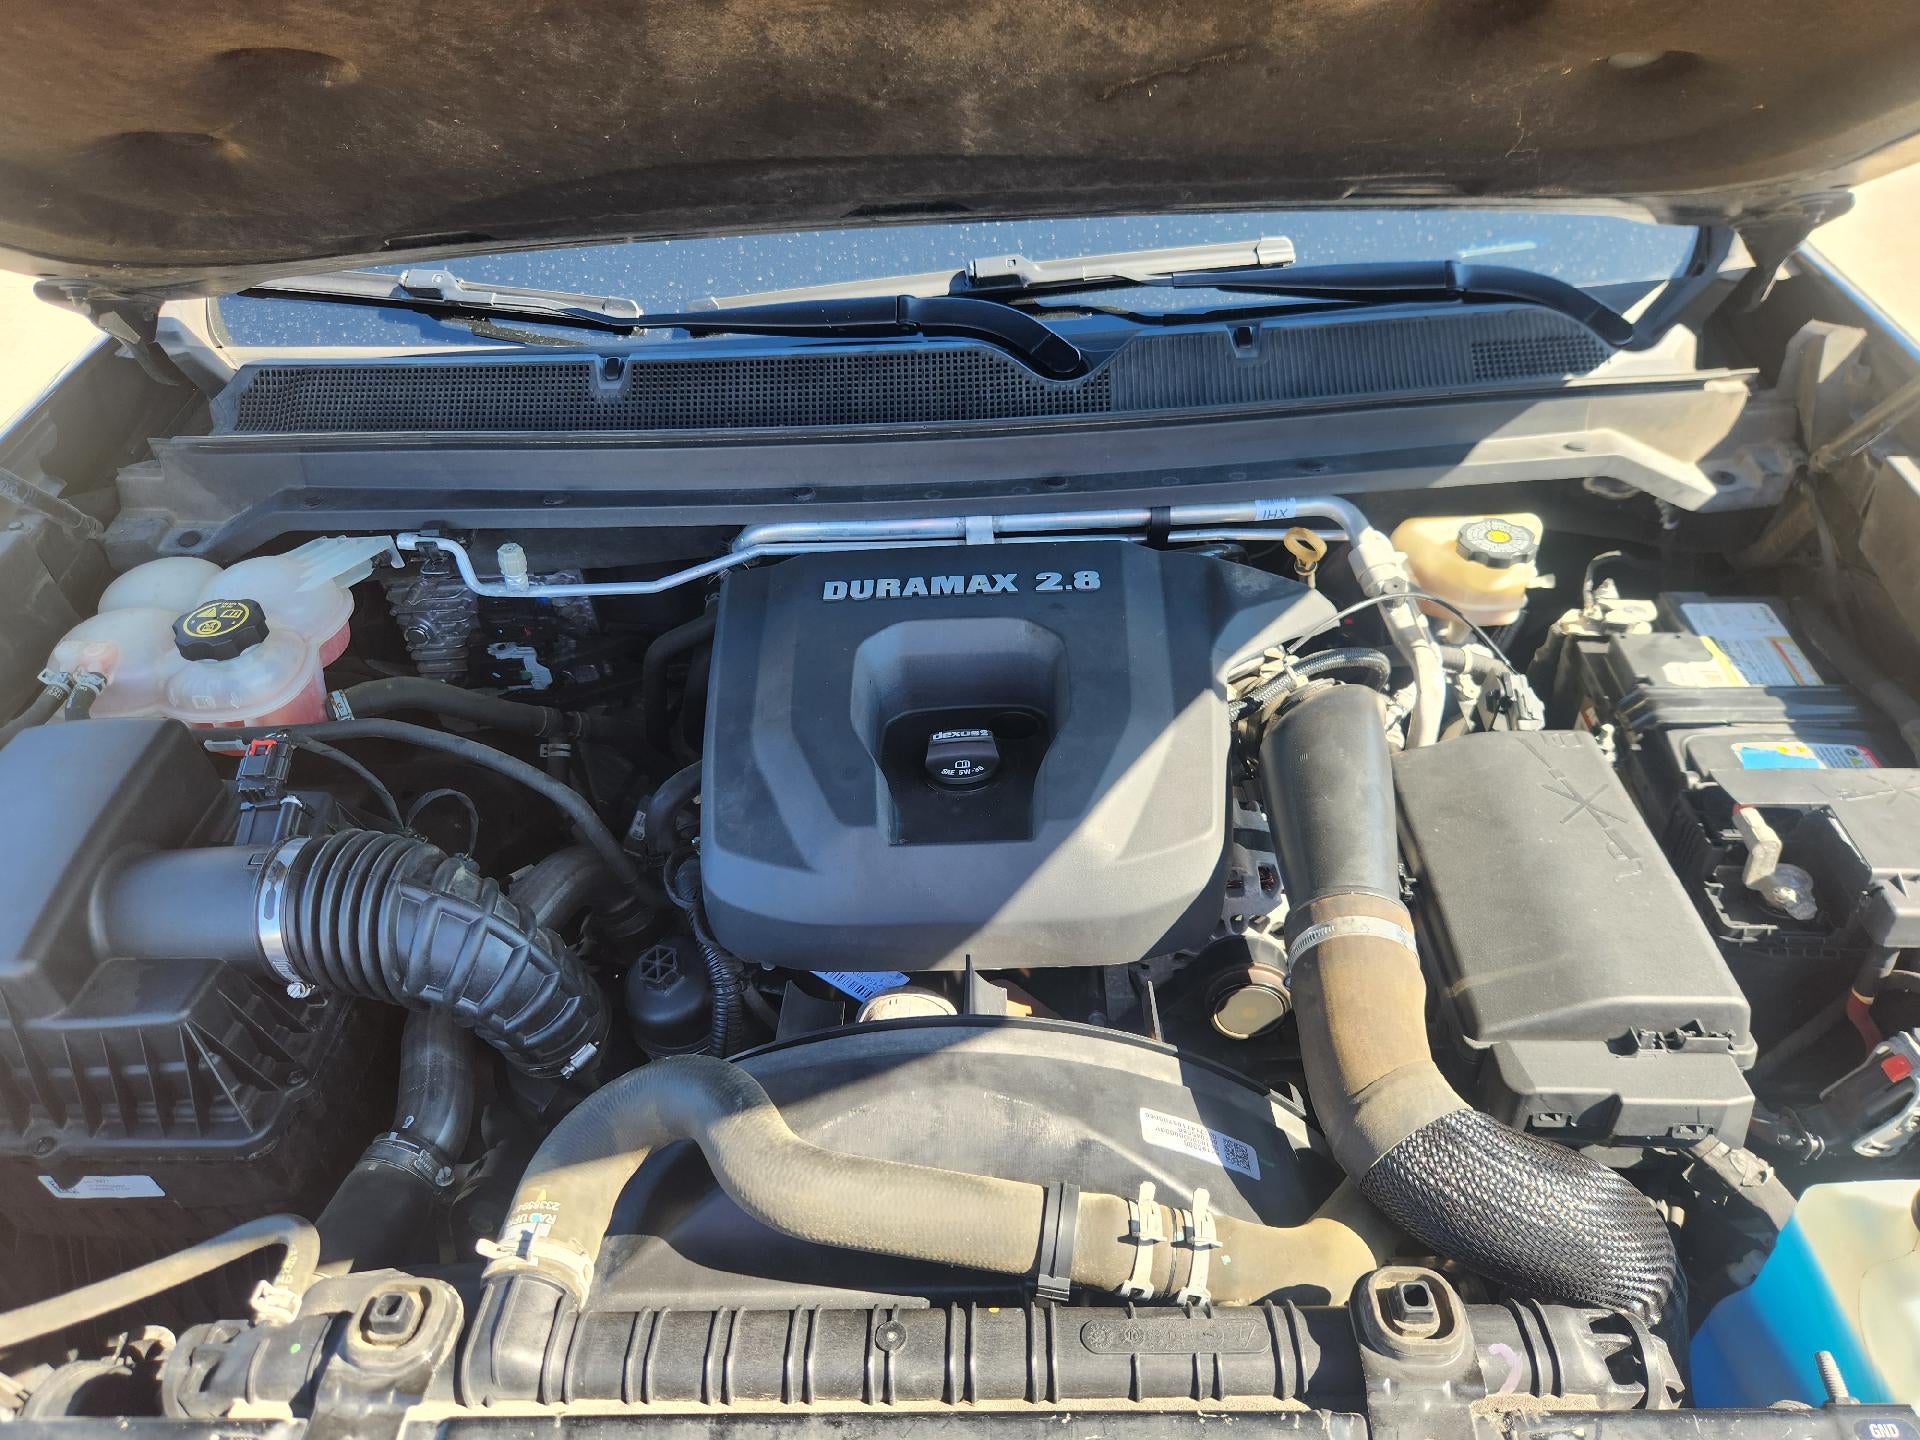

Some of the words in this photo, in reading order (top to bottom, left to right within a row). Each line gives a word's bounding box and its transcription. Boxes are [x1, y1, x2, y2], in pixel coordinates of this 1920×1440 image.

[822, 572, 1019, 602] DURAMAX
[1035, 569, 1101, 592] 2.8
[1869, 1423, 1900, 1438] GND
